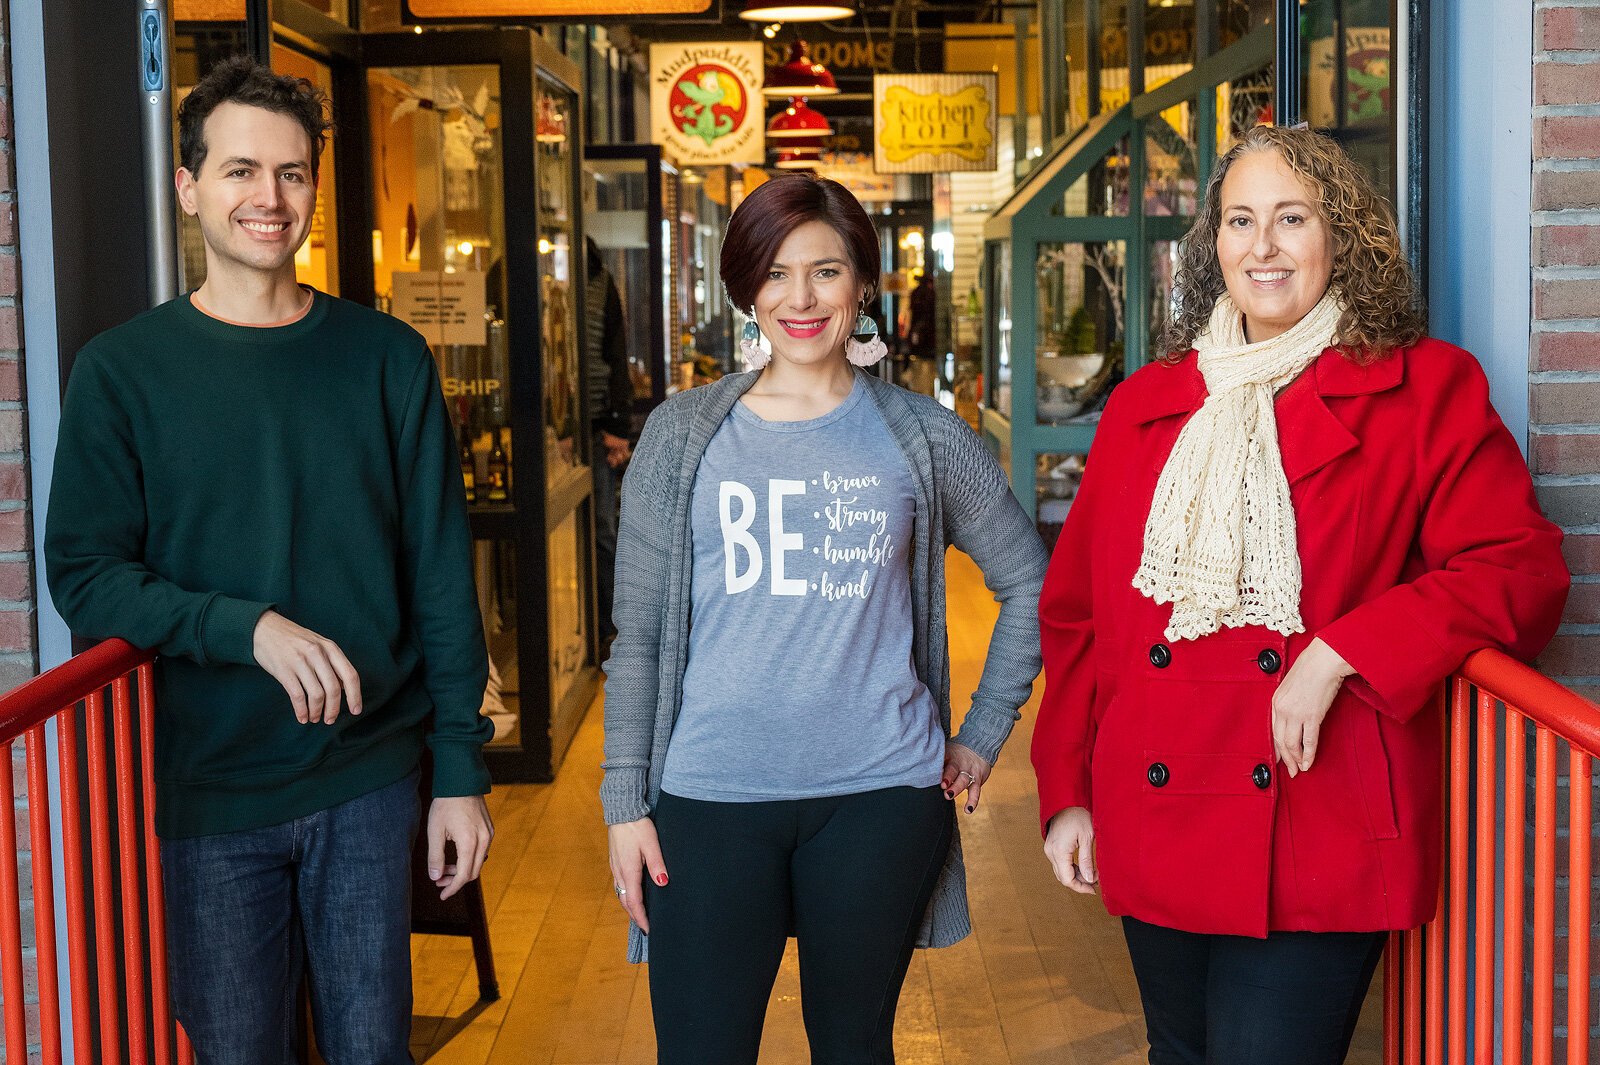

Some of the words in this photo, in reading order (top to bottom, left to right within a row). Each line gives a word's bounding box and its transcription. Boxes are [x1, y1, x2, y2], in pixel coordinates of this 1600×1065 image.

[657, 47, 757, 88] Mudpuddles
[898, 99, 975, 124] Kitchen
[822, 470, 880, 494] brave
[824, 496, 889, 535] strong
[719, 478, 808, 596] BE
[825, 534, 894, 567] humble
[821, 569, 872, 601] kind
